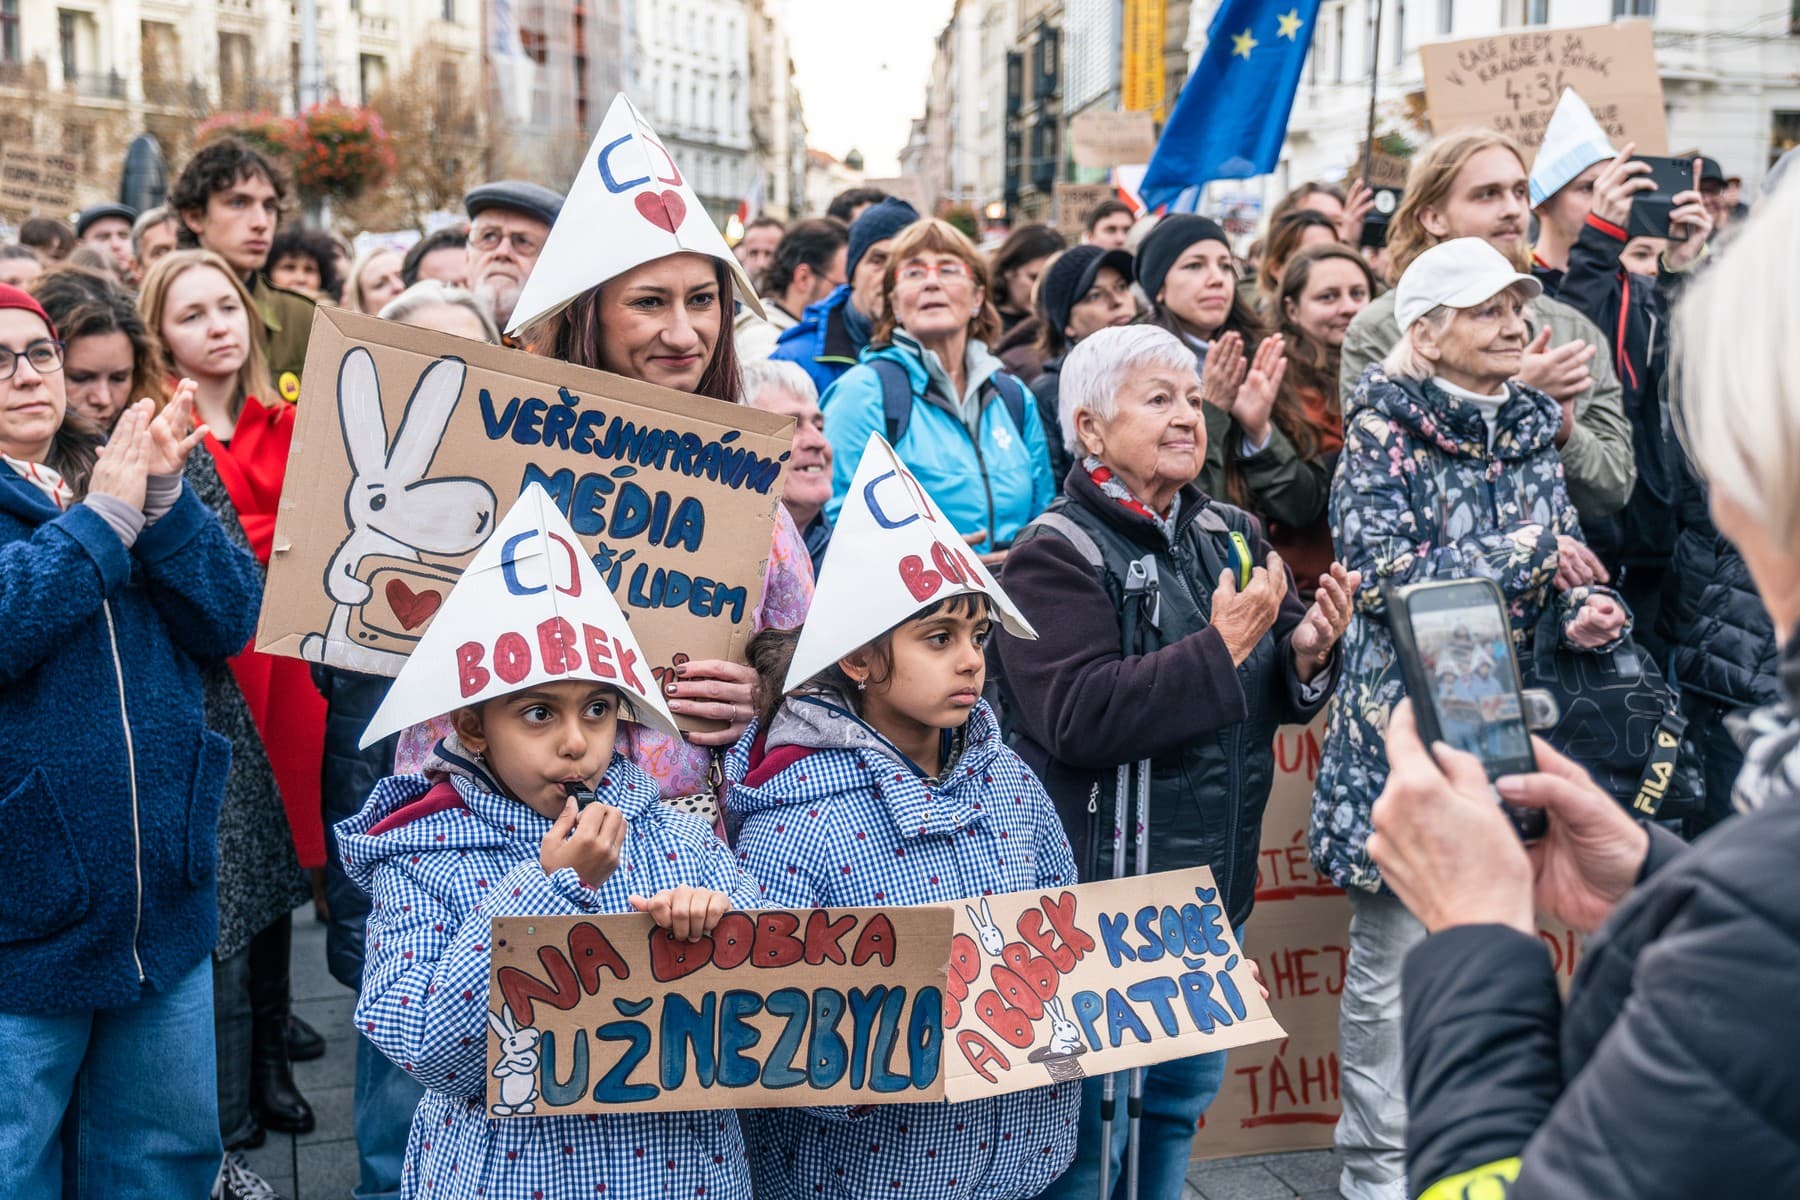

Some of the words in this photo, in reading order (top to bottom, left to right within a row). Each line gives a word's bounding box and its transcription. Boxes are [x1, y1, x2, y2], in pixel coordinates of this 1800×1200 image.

[479, 386, 792, 495] VEŘEJNOPRÁVNÍ
[518, 462, 705, 552] MÉDIA
[627, 563, 747, 624] LIDEM
[456, 616, 646, 698] BOBEK
[1633, 761, 1673, 815] FILA
[497, 922, 630, 1027] NA
[649, 909, 896, 982] BOBKA
[975, 891, 1095, 1049] BOBEK
[1072, 954, 1247, 1052] PATŘÍ
